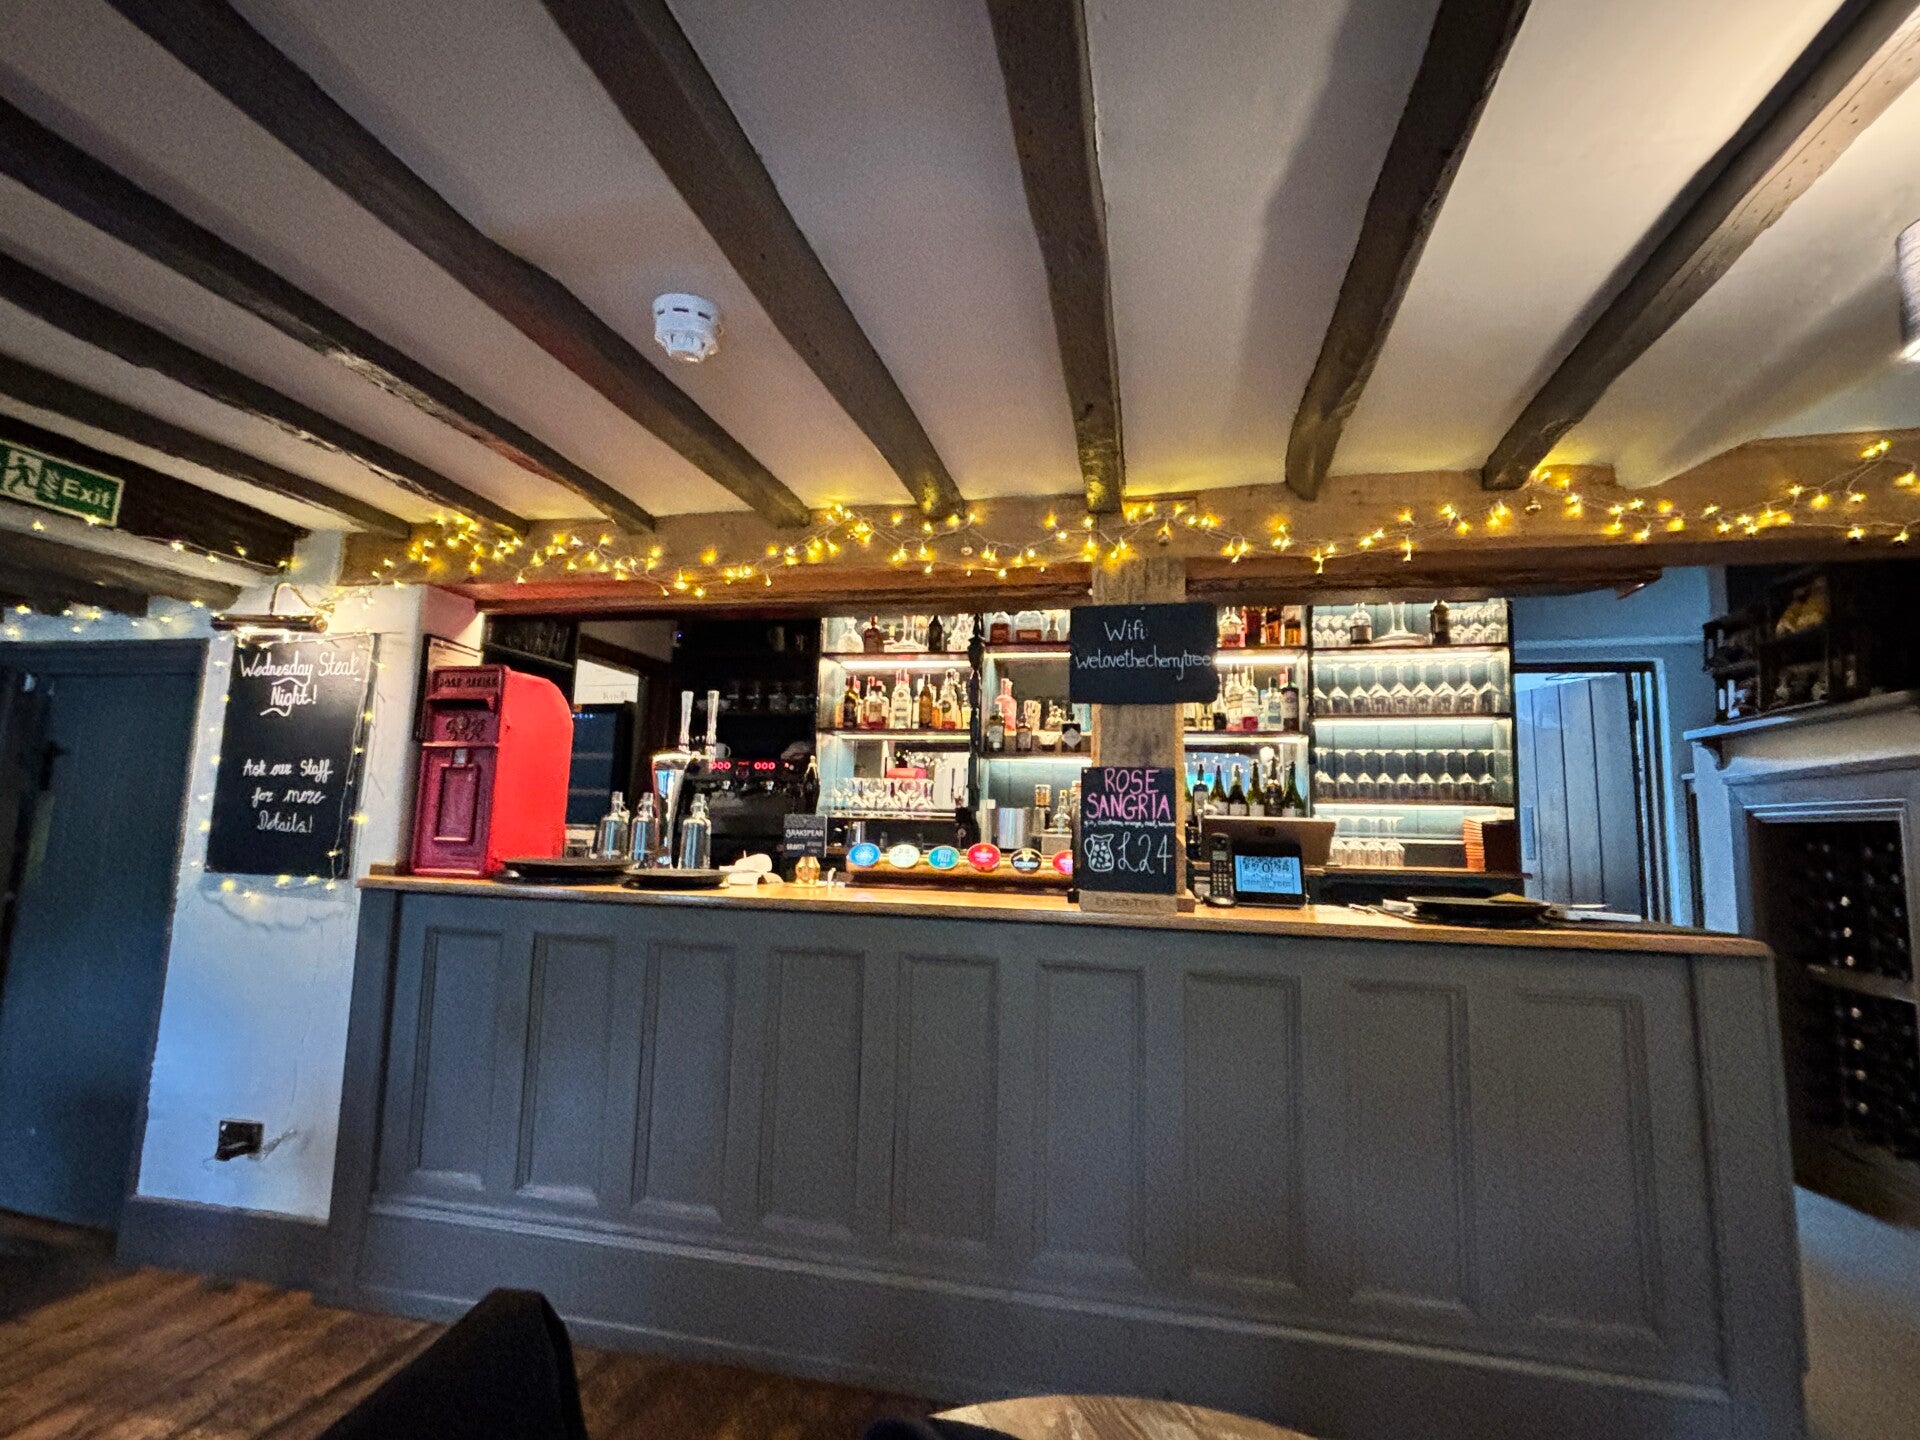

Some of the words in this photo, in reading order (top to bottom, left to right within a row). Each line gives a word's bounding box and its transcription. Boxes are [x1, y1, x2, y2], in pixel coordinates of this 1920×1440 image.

[61, 478, 111, 509] Exit
[240, 650, 313, 687] Wednesday
[318, 651, 360, 677] Steak
[1075, 645, 1212, 681] welovethecherrytree
[265, 684, 317, 716] Night!
[243, 758, 266, 777] Ask
[270, 763, 292, 777] our
[300, 758, 333, 783] Staff
[1104, 768, 1159, 794] ROSE
[251, 787, 273, 808] for
[283, 789, 326, 804] more
[1086, 792, 1171, 820] SANGRIA
[257, 810, 313, 833] Details!
[1118, 831, 1173, 875] £24
